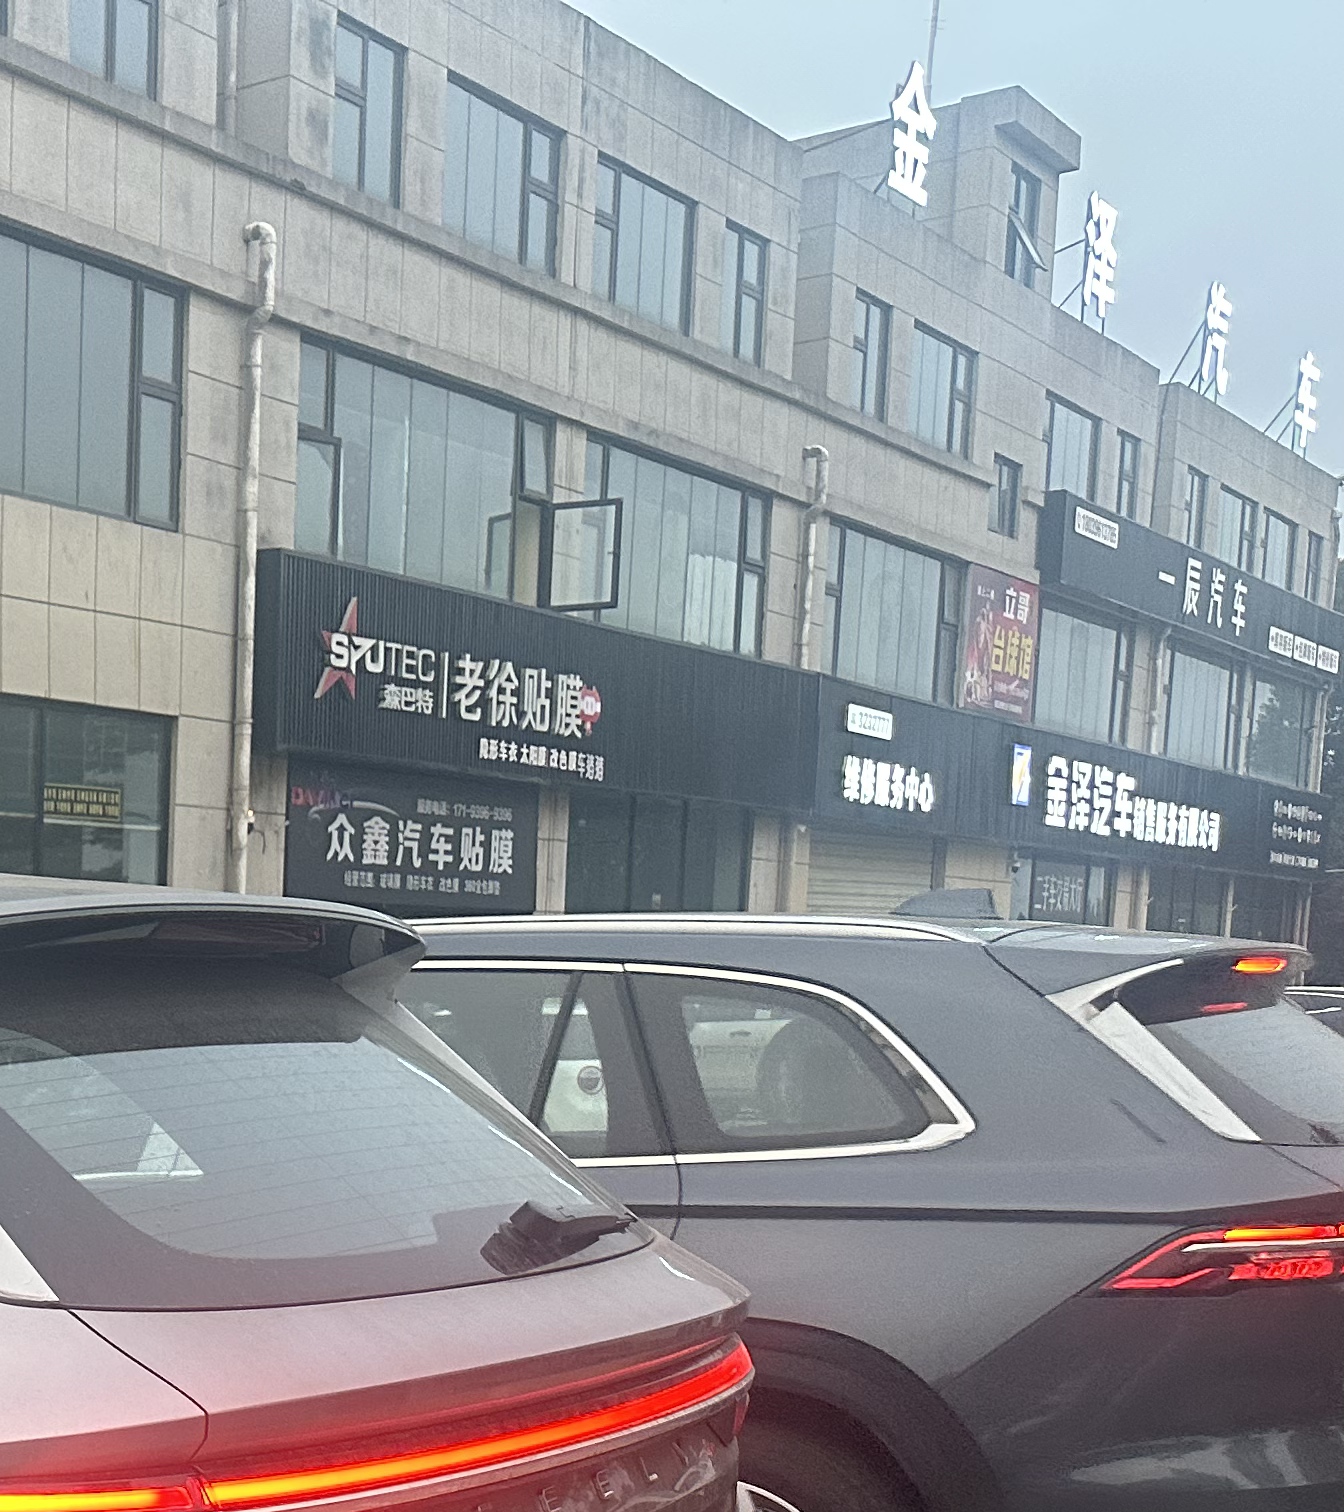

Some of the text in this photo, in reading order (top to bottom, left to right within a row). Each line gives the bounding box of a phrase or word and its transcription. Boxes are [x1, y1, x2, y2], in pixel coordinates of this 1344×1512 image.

[1003, 587, 1030, 625] 立哥
[1158, 558, 1248, 637] 一辰汽车
[991, 625, 1033, 681] 台球馆
[452, 653, 583, 739] 老徐贴膜
[842, 754, 934, 812] 维修服务中心
[325, 813, 515, 874] 众鑫汽车贴膜
